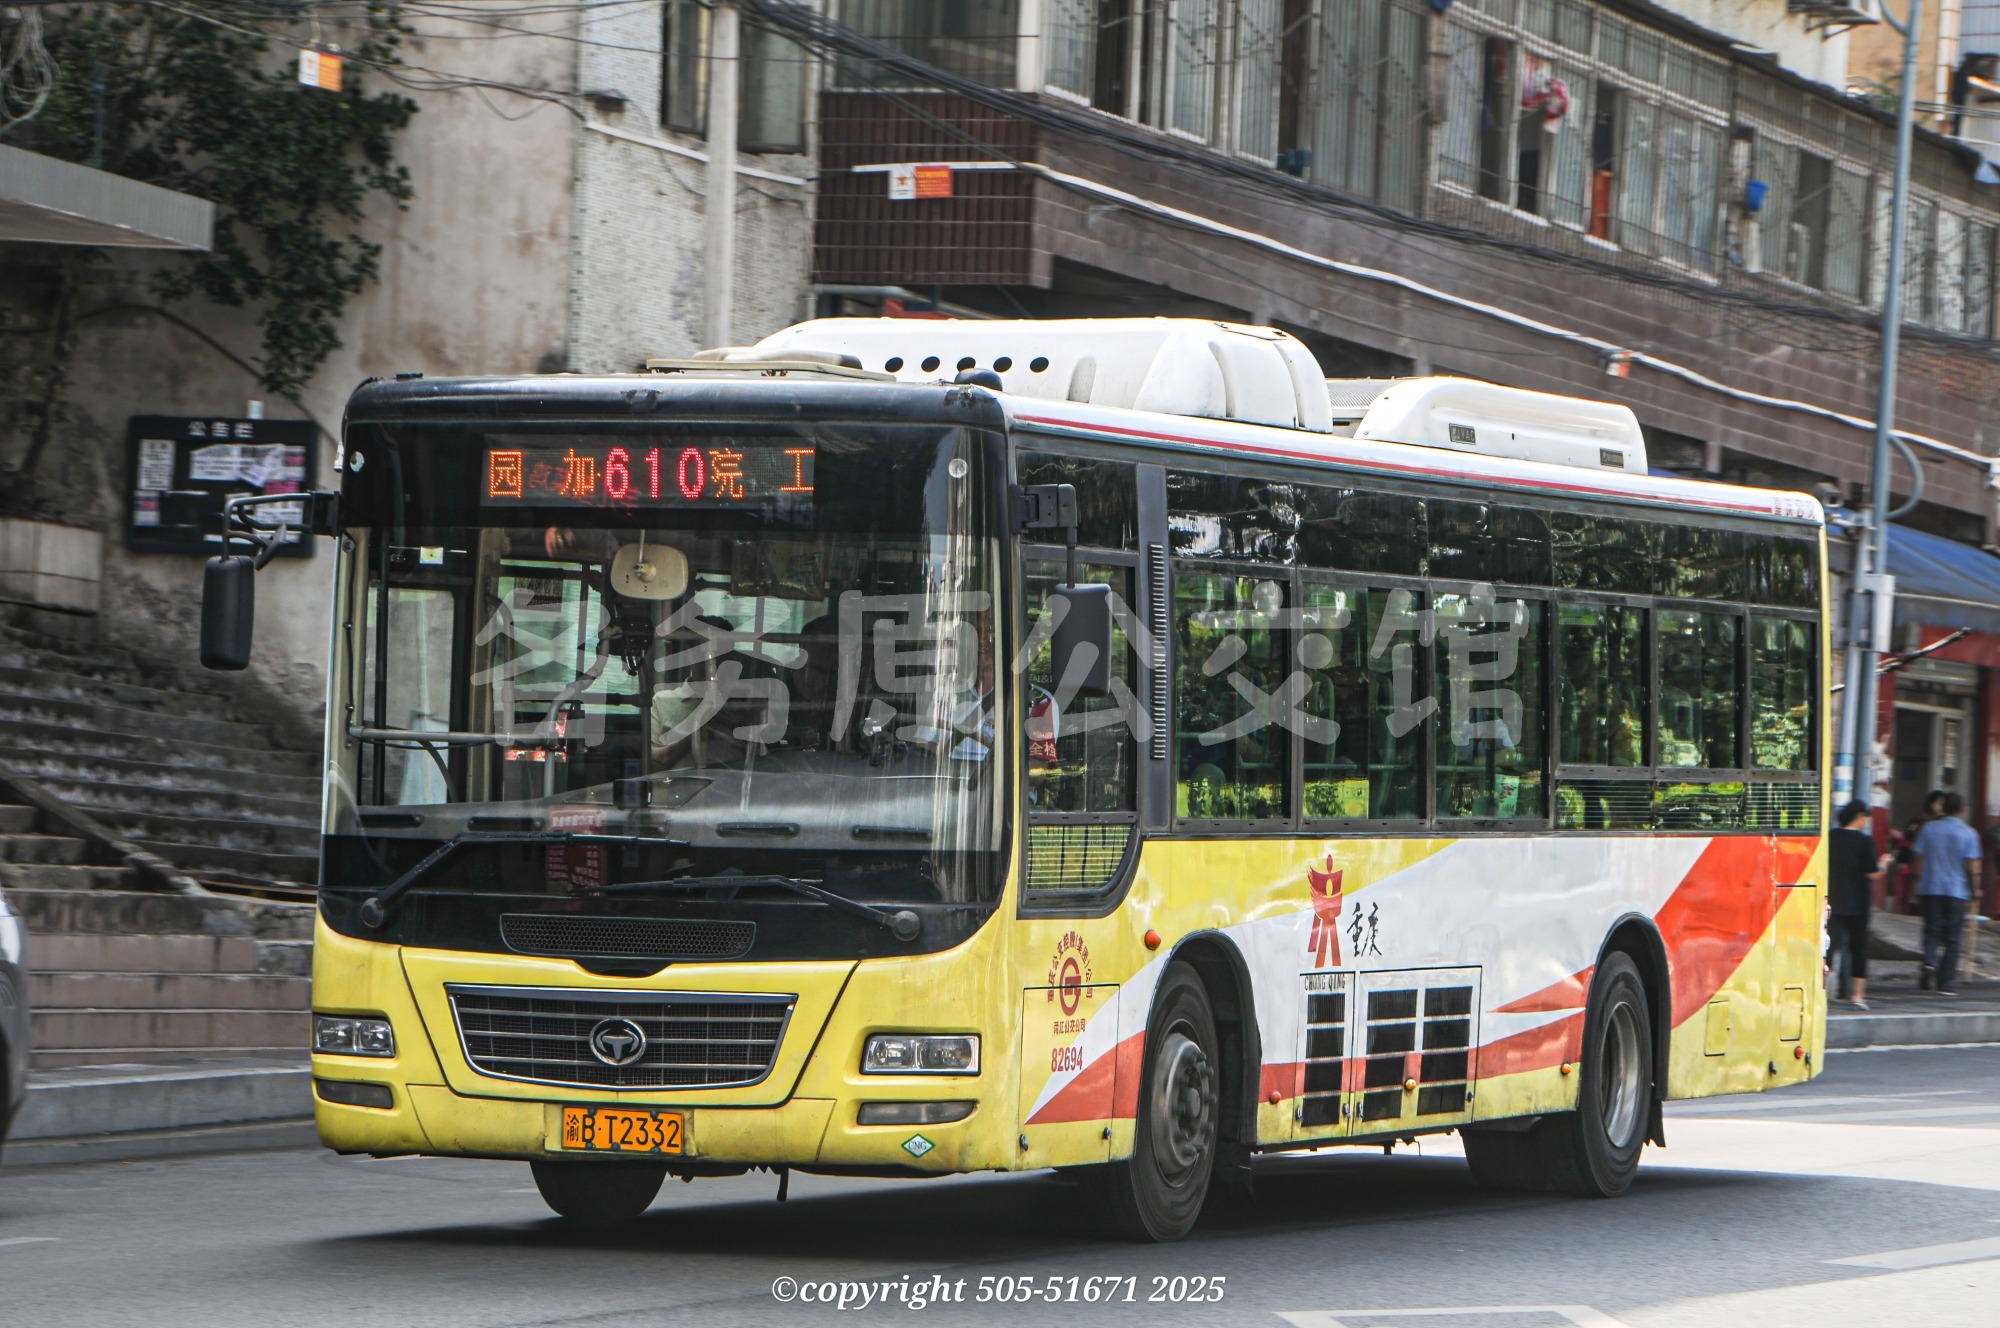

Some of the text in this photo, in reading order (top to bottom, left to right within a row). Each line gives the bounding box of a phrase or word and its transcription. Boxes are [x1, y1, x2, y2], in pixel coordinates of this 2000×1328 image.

[605, 447, 706, 500] 610
[1304, 974, 1346, 991] CHONG QING
[1051, 1046, 1083, 1073] 82694
[908, 1140, 927, 1150] CNG
